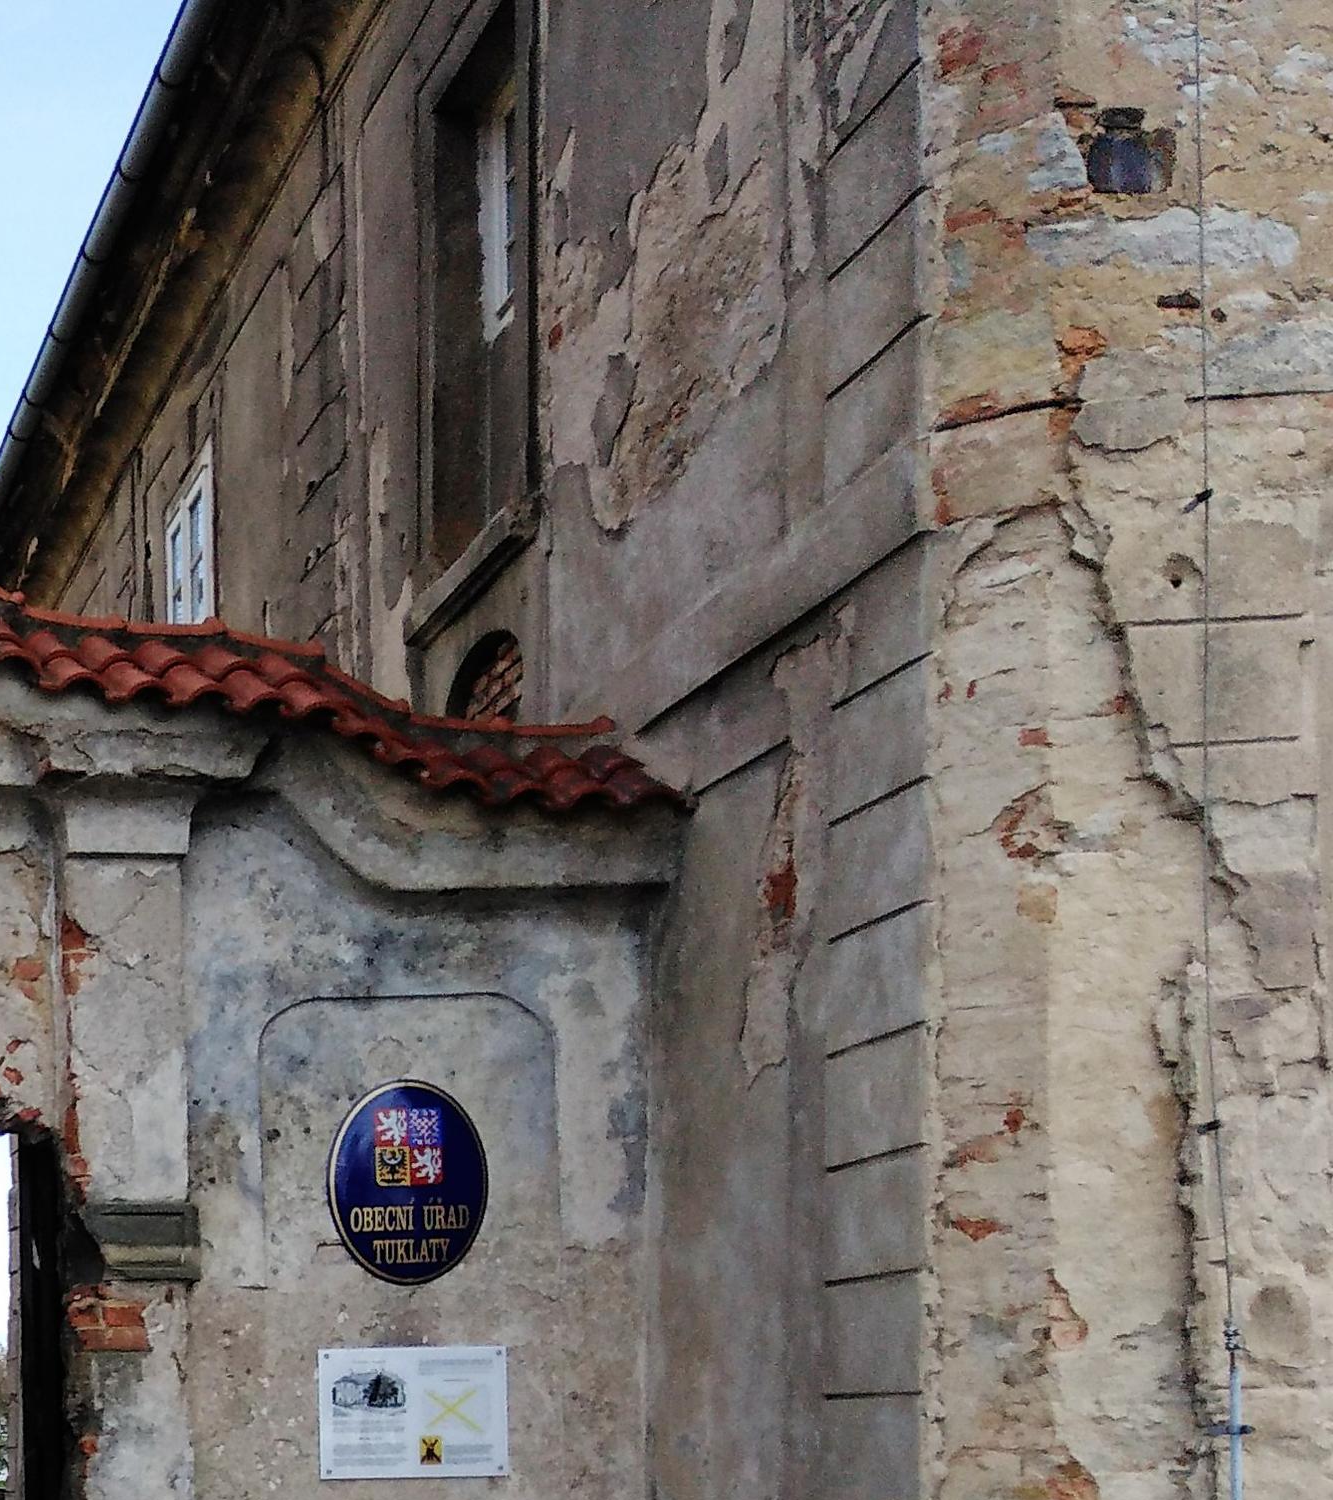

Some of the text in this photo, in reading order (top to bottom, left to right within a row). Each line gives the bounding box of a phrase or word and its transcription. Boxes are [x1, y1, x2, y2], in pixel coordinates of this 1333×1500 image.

[350, 1197, 470, 1232] OBECNÍ ÚŘAD
[373, 1238, 450, 1264] TUKLATY
